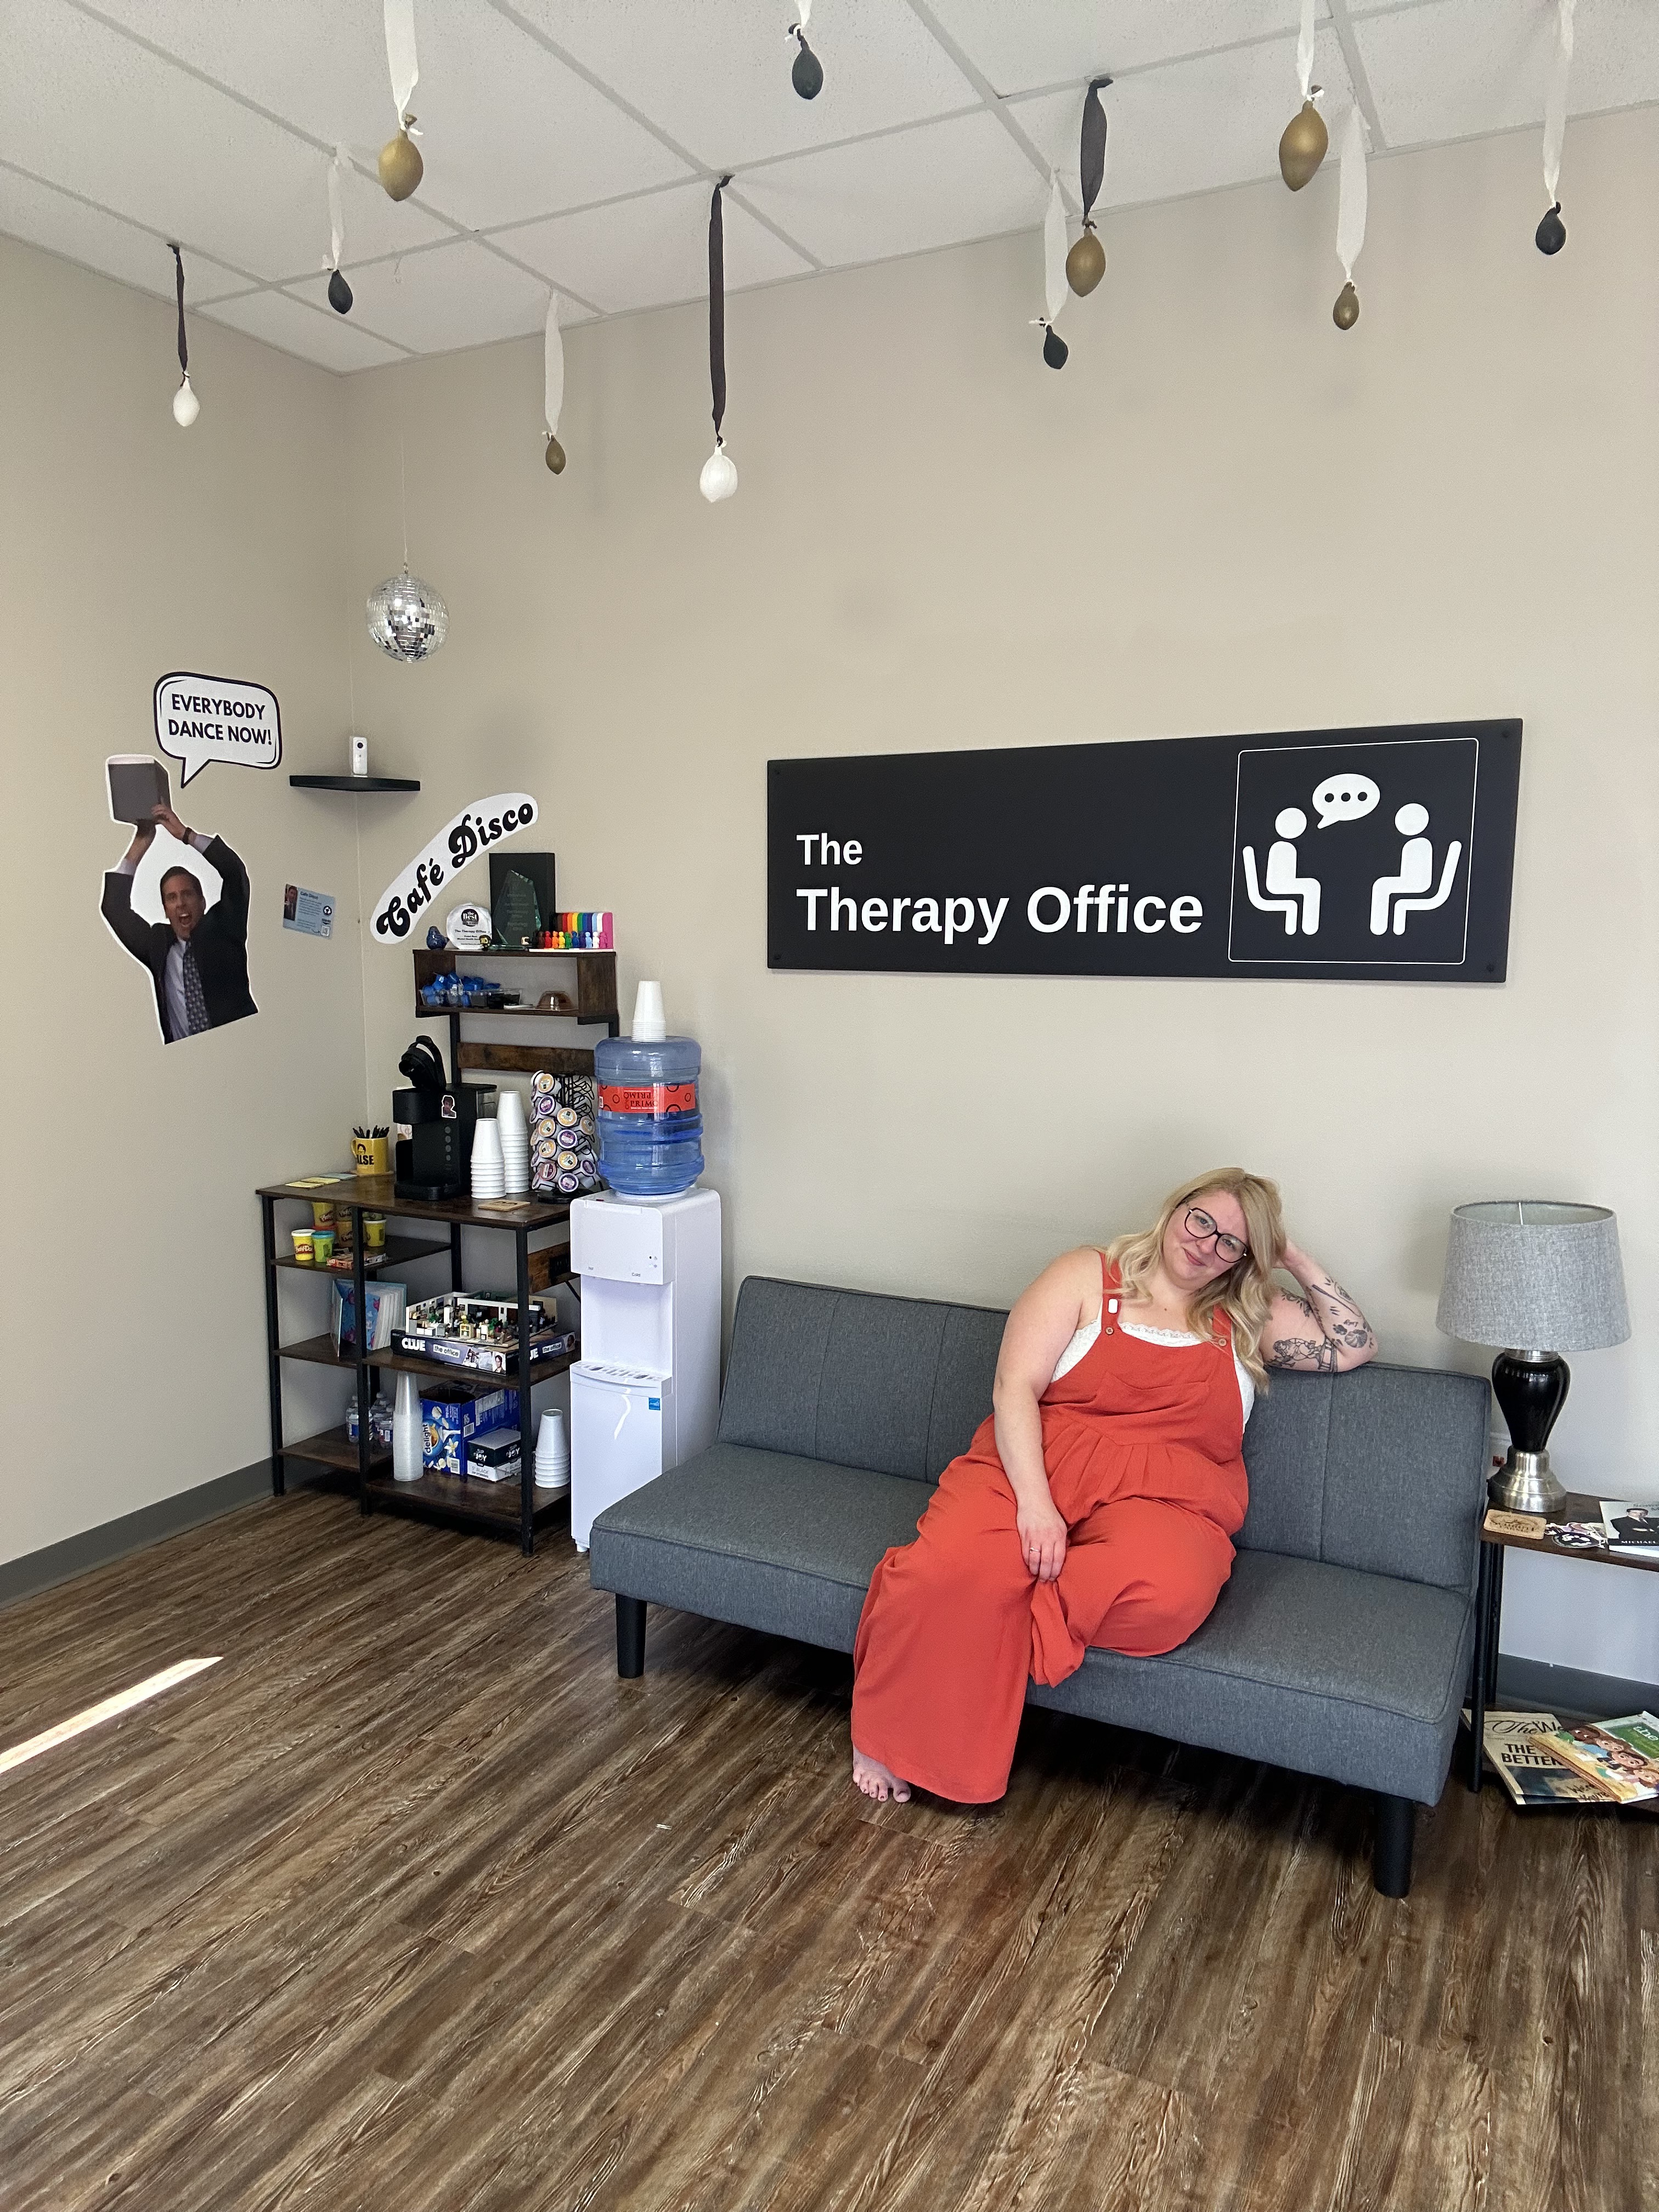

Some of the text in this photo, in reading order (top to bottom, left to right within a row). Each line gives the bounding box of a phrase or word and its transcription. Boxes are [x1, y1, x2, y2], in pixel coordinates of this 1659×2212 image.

[172, 693, 266, 720] EVERYBODY
[168, 719, 272, 746] DANCE NOW!
[796, 832, 862, 865] The
[376, 857, 444, 937] Café
[448, 803, 533, 868] Disco
[796, 883, 1203, 945] Therapy Office
[357, 1154, 374, 1165] LSE
[402, 1338, 426, 1351] CLUE
[444, 1348, 459, 1357] office
[422, 1424, 432, 1453] delight
[1483, 1720, 1537, 1734] The
[1504, 1743, 1536, 1754] THE
